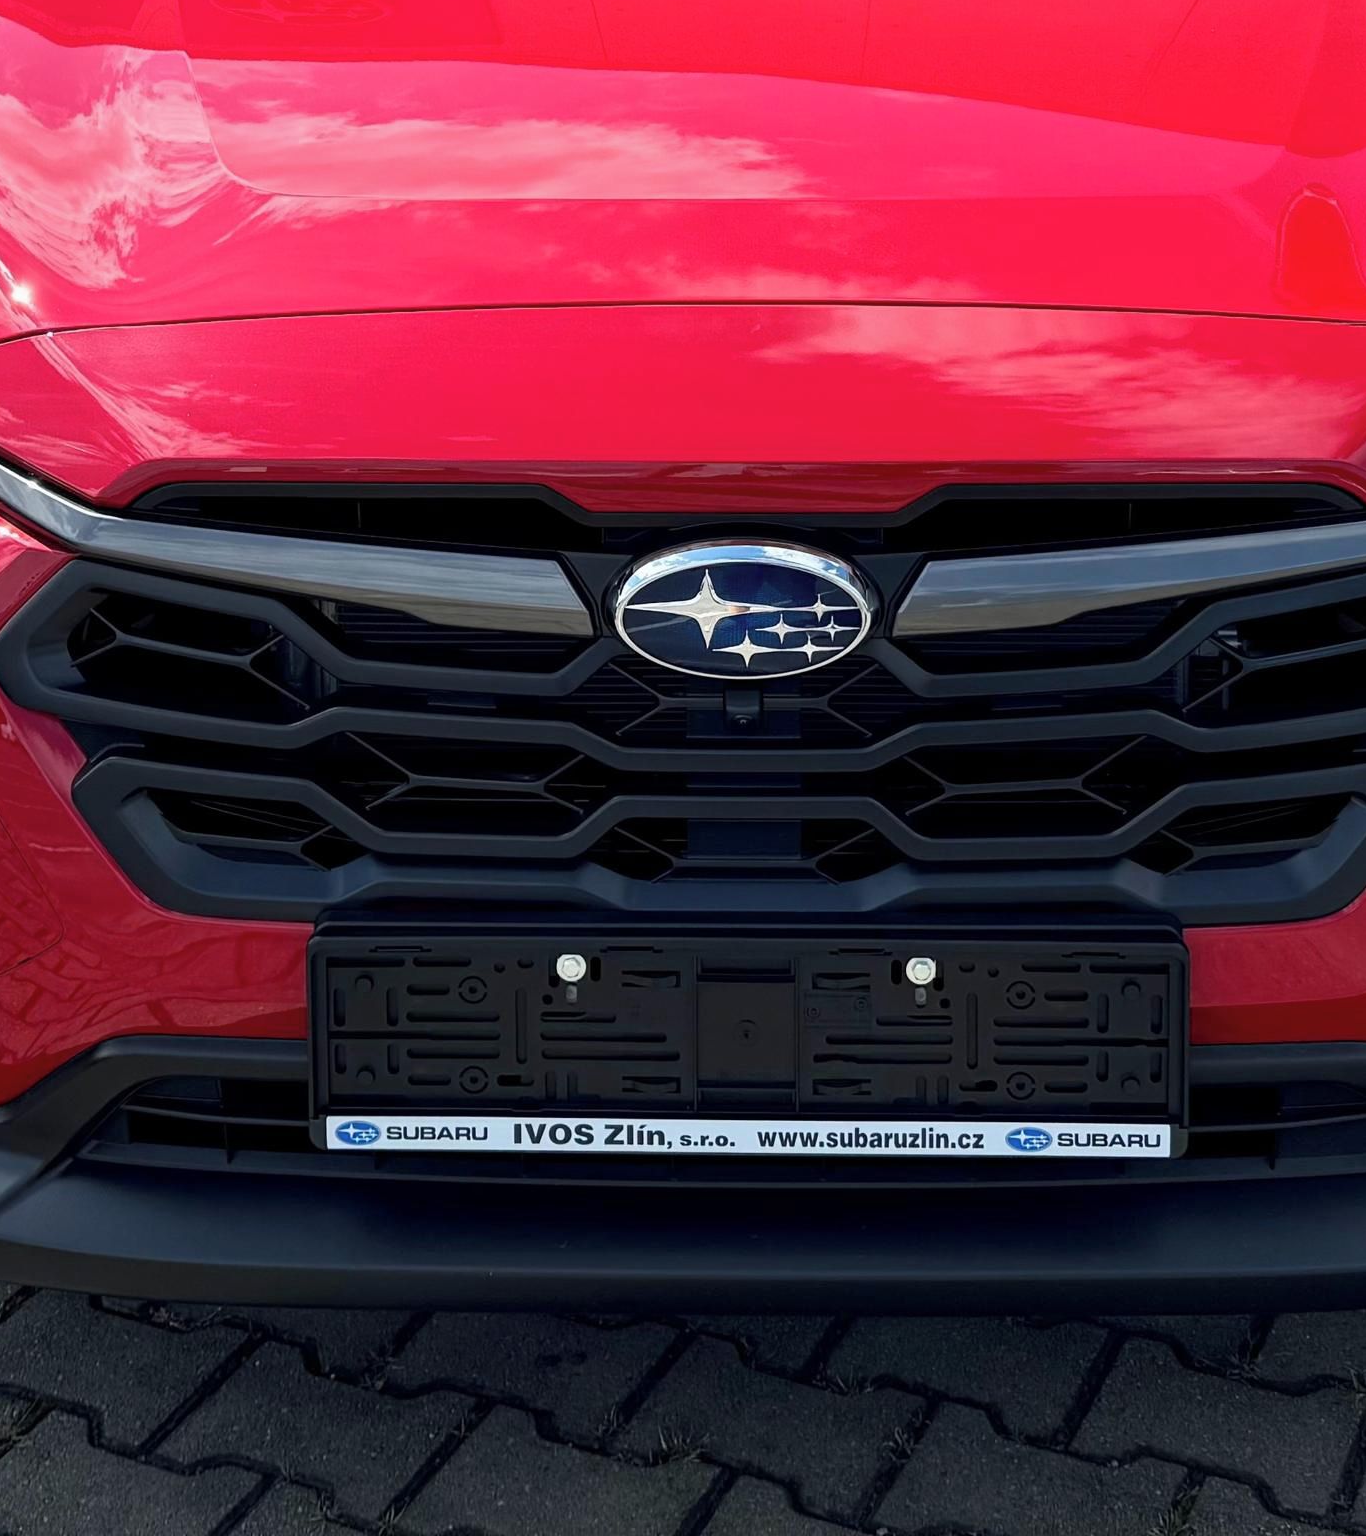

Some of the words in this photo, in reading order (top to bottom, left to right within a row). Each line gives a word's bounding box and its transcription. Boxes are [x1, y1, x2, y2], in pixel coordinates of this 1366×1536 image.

[386, 1125, 488, 1141] SUBARU
[513, 1123, 595, 1145] IVOS
[604, 1123, 674, 1149] Zlín,
[679, 1131, 736, 1147] s.r.o.
[757, 1128, 985, 1149] www.subaruzlin.cz
[1057, 1132, 1161, 1148] SUBARU
